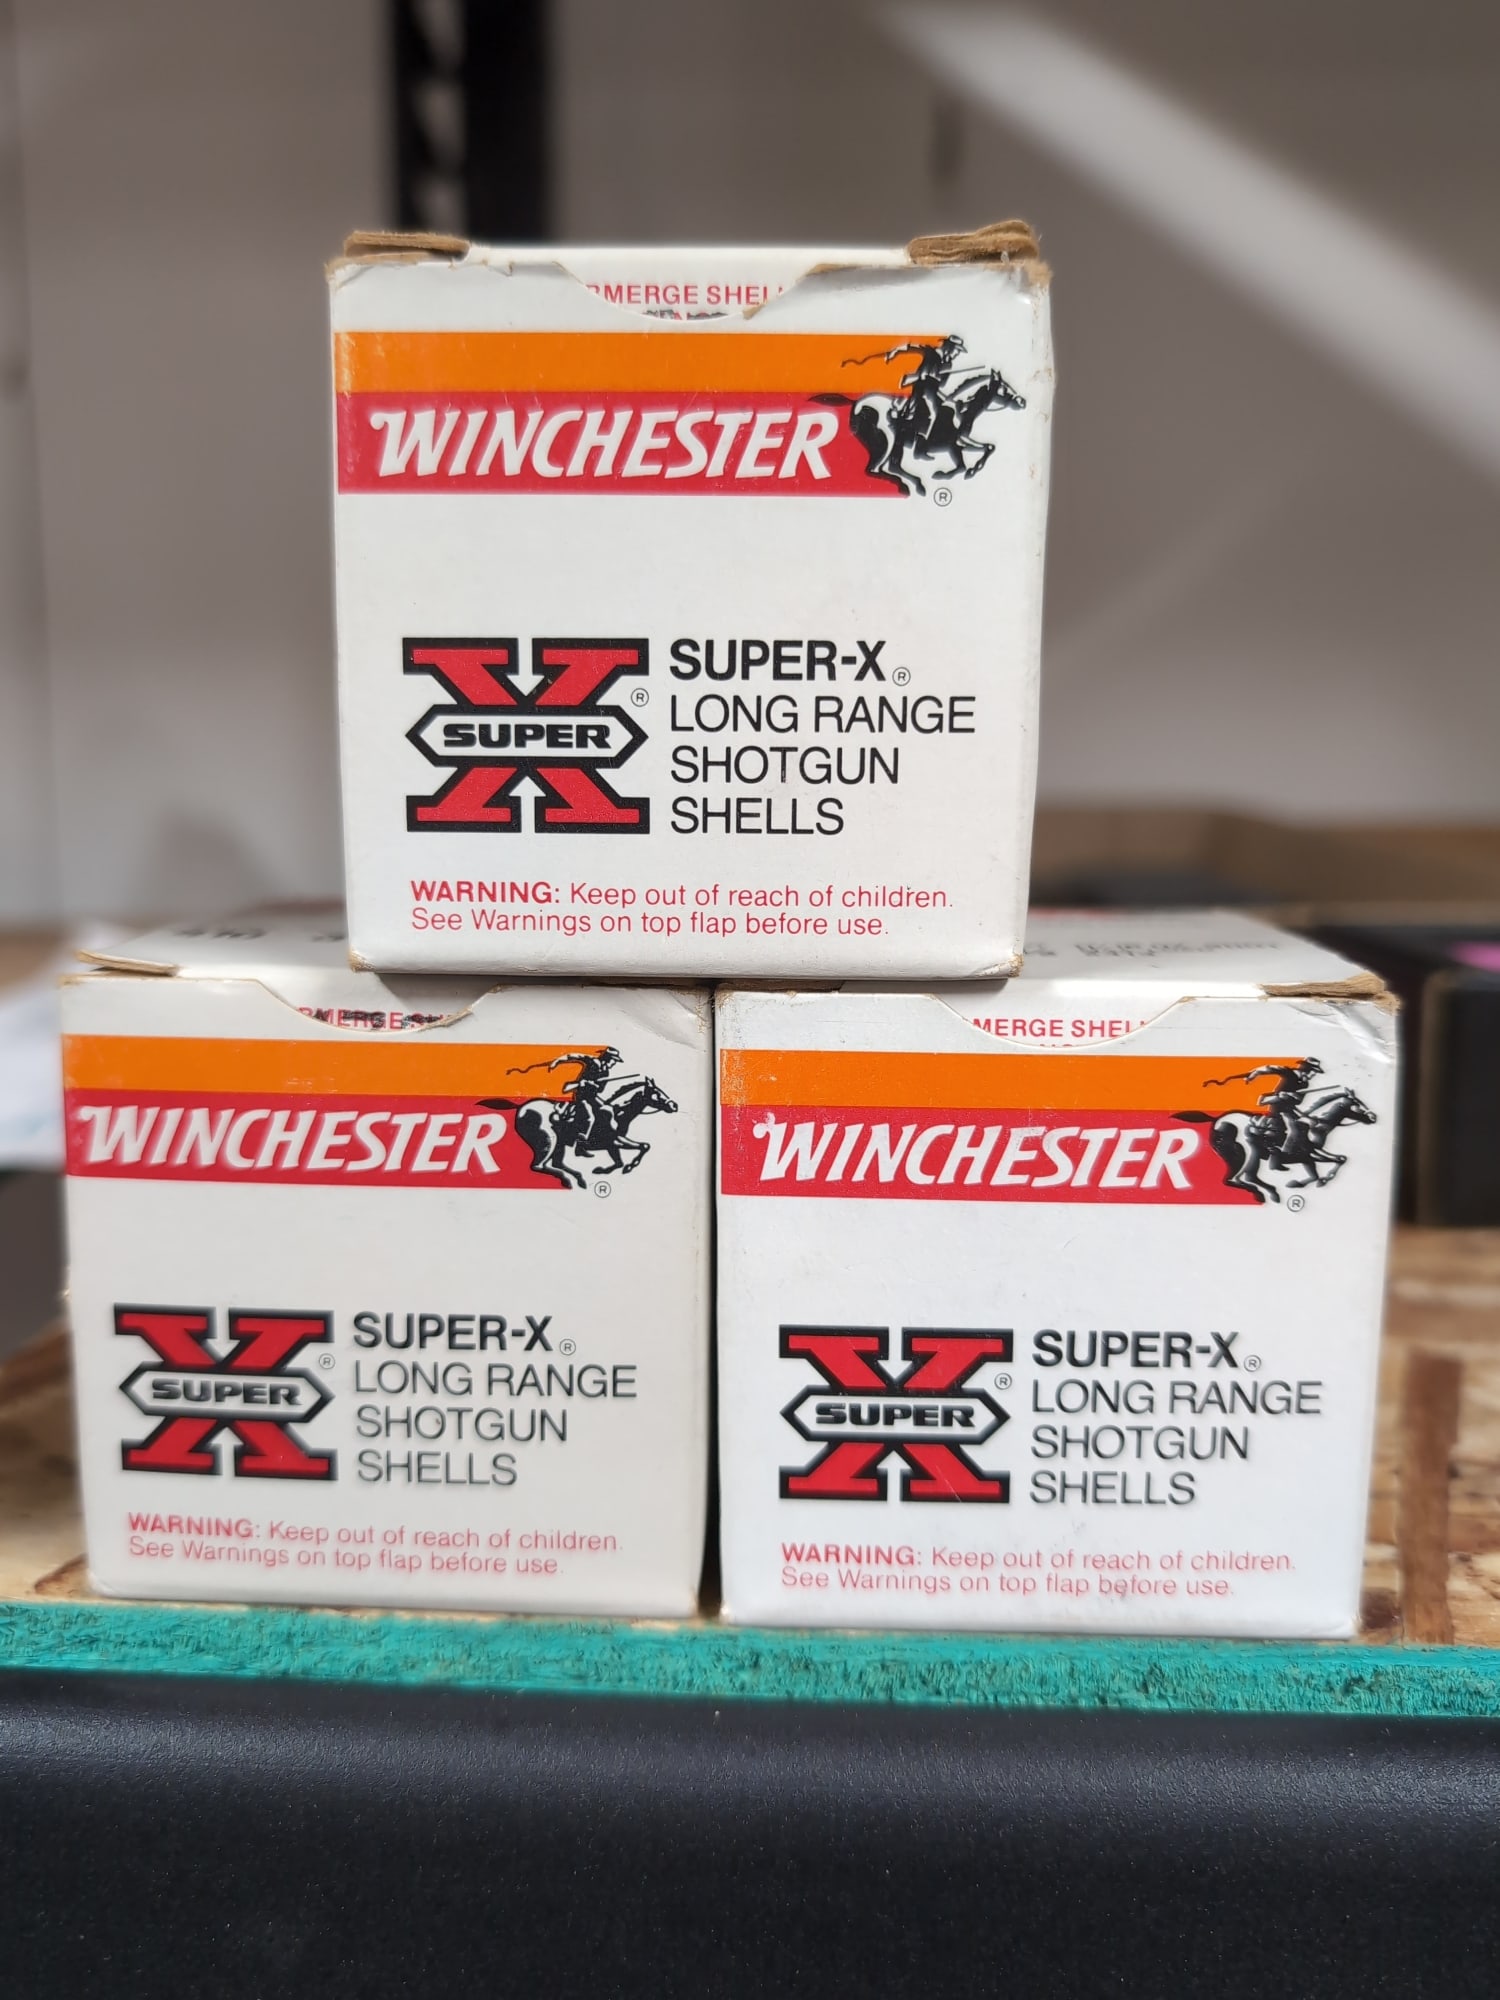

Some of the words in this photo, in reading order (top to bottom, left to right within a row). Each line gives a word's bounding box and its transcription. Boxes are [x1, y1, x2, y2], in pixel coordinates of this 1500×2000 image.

[370, 408, 838, 479] WINCHESTER
[671, 694, 798, 733] LONG
[814, 695, 976, 734] RANGE
[443, 723, 611, 749] SUPER
[671, 745, 898, 785] SHOTGUN
[671, 796, 844, 835] SHELLS
[410, 879, 562, 907] WARNING:
[569, 881, 637, 914] Keep
[644, 881, 688, 908] out
[694, 881, 722, 908] of
[728, 881, 801, 909] reach
[808, 881, 835, 909] of
[841, 881, 954, 910] children.
[410, 908, 464, 932] See
[469, 907, 593, 937] Warnings
[599, 910, 634, 934] on
[640, 910, 683, 939] top
[689, 910, 738, 939] flap
[744, 910, 829, 937] before
[836, 913, 890, 937] use.
[77, 1106, 506, 1173] WINCHESTER
[753, 1117, 1200, 1189] WINCHESTER
[151, 1377, 304, 1407] SUPER
[355, 1360, 472, 1396] LONG
[488, 1364, 637, 1398] RANGE
[1033, 1379, 1154, 1414] LONG
[1169, 1381, 1322, 1415] RANGE
[357, 1405, 567, 1442] SHOTGUN
[816, 1403, 975, 1428] SUPER
[1031, 1425, 1248, 1460] SHOTGUN
[358, 1450, 517, 1486] SHELLS
[1030, 1471, 1195, 1505] SHELLS
[127, 1511, 261, 1539] WARNING:
[269, 1520, 329, 1545] Keep
[336, 1522, 375, 1546] out
[382, 1523, 405, 1546] of
[413, 1526, 481, 1547] reach
[487, 1527, 511, 1549] of
[518, 1527, 623, 1551] children.
[128, 1538, 176, 1559] See
[181, 1540, 291, 1567] Warnings
[297, 1546, 327, 1566] on
[334, 1546, 372, 1571] top
[377, 1547, 423, 1573] flap
[430, 1550, 508, 1573] before
[514, 1556, 564, 1575] use.
[781, 1543, 922, 1566] WARNING:
[931, 1547, 996, 1571] Keep
[1003, 1548, 1044, 1568] out
[1050, 1548, 1074, 1569] of
[1081, 1548, 1152, 1570] reach
[1159, 1548, 1183, 1571] of
[1190, 1549, 1296, 1572] children.
[781, 1566, 832, 1588] See
[838, 1566, 952, 1594] Warnings
[959, 1571, 991, 1592] on
[998, 1571, 1037, 1596] top
[1044, 1571, 1091, 1596] flap
[1097, 1573, 1179, 1597] before
[1185, 1577, 1235, 1596] use.
